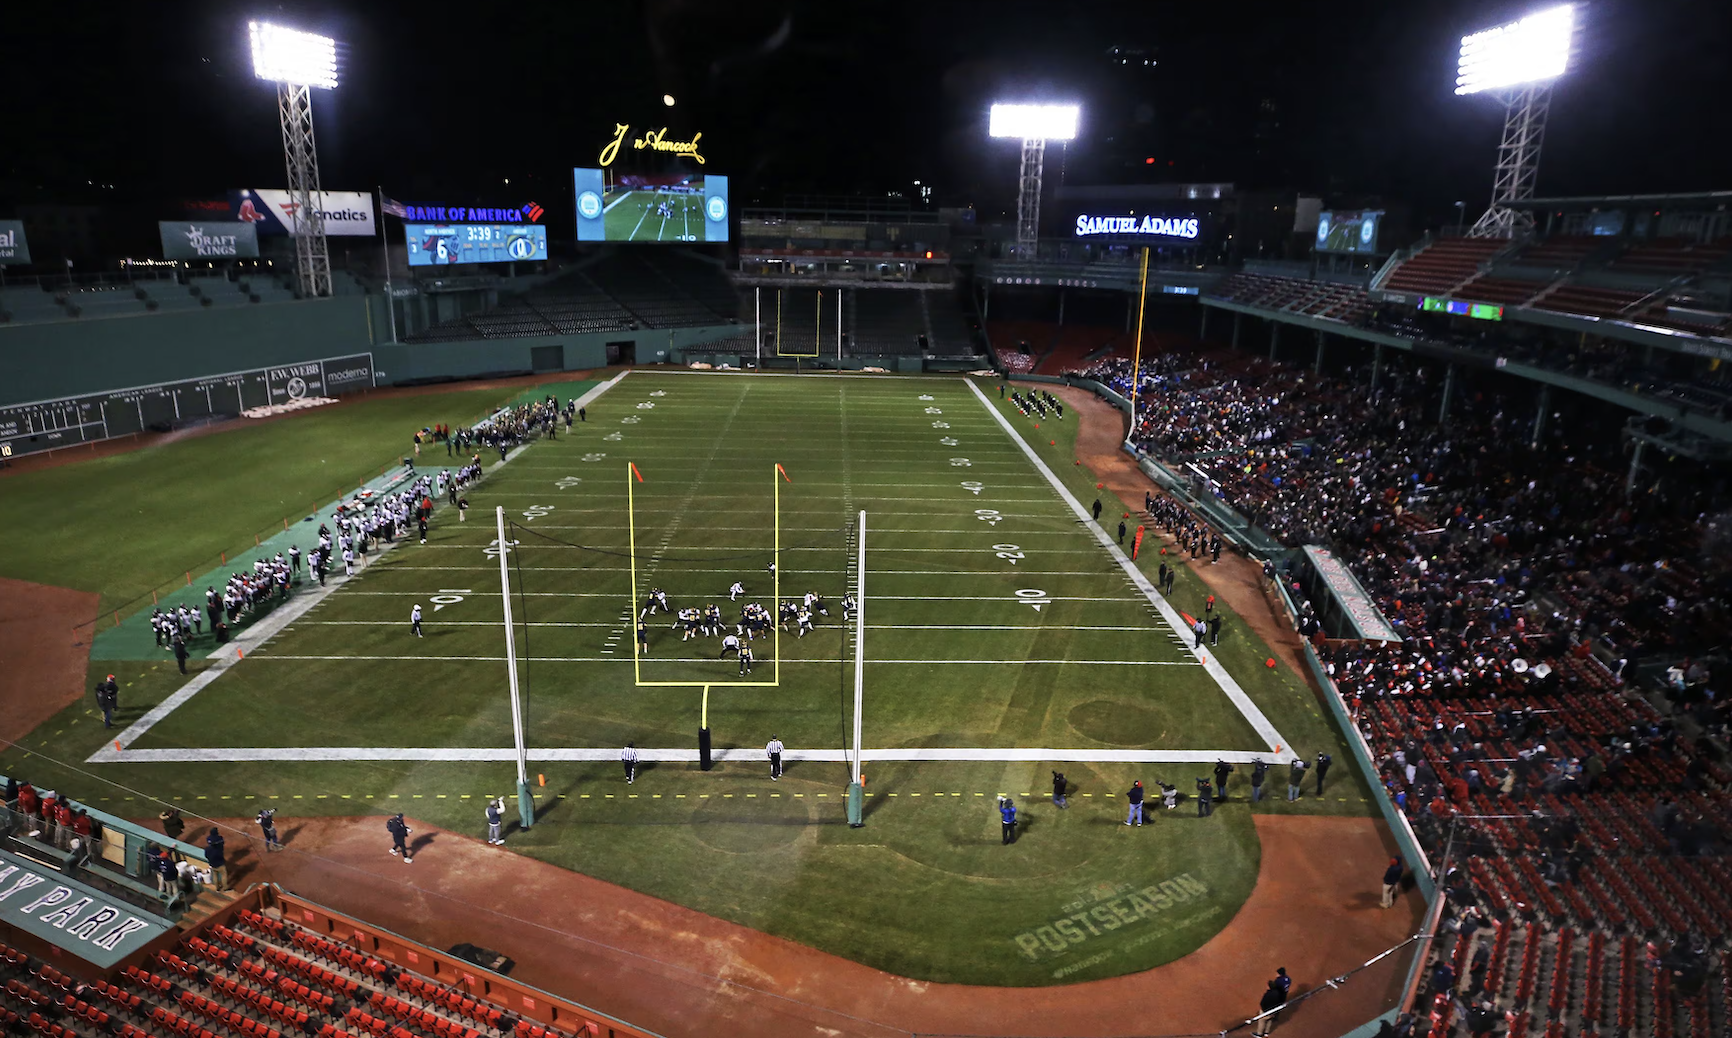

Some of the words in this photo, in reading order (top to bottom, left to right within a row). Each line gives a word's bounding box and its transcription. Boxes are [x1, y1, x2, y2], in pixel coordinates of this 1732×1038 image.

[600, 123, 647, 166] Jn
[646, 127, 705, 164] Hancock
[406, 206, 447, 221] BANK
[448, 207, 466, 221] OF
[467, 208, 522, 222] AMERICA
[467, 226, 491, 241] 3:39
[1076, 214, 1139, 236] SAMUEL
[1139, 214, 1198, 239] ADAMS
[190, 234, 236, 248] DRAFT
[197, 245, 237, 256] KINGS
[436, 239, 448, 259] 6
[290, 364, 320, 377] WEBB
[328, 367, 368, 381] moderna
[522, 505, 555, 517] 30
[974, 509, 1003, 521] 30
[992, 543, 1025, 558] 20
[430, 589, 471, 604] 10
[1015, 589, 1051, 604] 10
[20, 886, 149, 951] PARK
[1015, 873, 1208, 959] POSTSEASON
